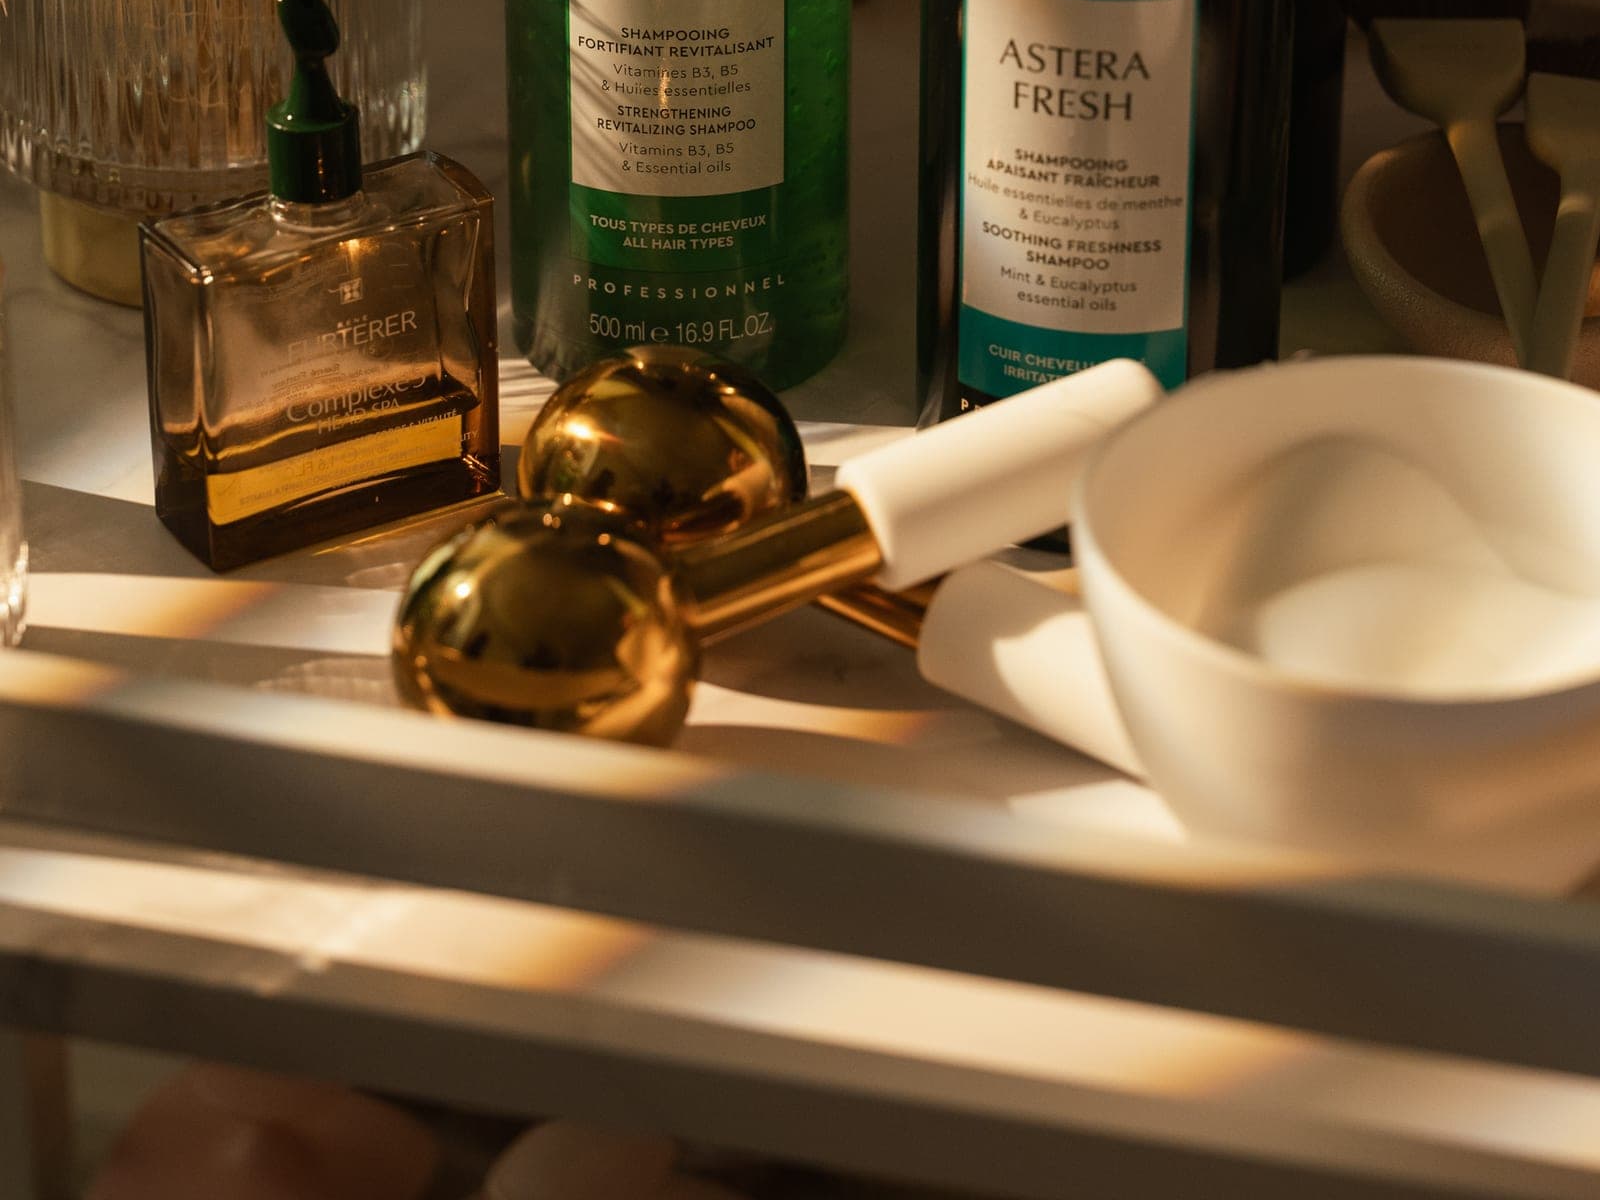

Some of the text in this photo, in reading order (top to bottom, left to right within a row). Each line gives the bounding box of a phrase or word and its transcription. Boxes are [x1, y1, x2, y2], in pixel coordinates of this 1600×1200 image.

[621, 27, 730, 42] SHAMPOOING
[578, 35, 775, 58] FORTIFIANT REVITALISANT
[999, 38, 1151, 81] ASTERA
[612, 63, 739, 81] Vitamines B3, B5
[601, 79, 611, 92] &
[664, 81, 751, 98] essentielles
[617, 105, 732, 120] STRENGTHENING
[1013, 81, 1134, 122] FRESH
[597, 118, 756, 136] REVITALIZING SHAMPOO
[619, 142, 735, 158] Vitamins B3, B5
[1014, 148, 1129, 173] SHAMPOOING
[621, 160, 732, 176] & Essential oils
[986, 158, 1059, 186] APAISANT
[1003, 186, 1092, 212] essentielles
[1096, 197, 1119, 211] de
[1122, 195, 1183, 212] menthe
[590, 214, 766, 235] TOUS TYPES DE CHEVEUX
[1018, 206, 1121, 232] & Eucalyptus
[623, 236, 734, 250] ALL HAIR TYPES
[982, 220, 1162, 254] SOOTHING FRESHNESS
[1026, 250, 1110, 272] SHAMPOO
[573, 273, 785, 300] PROFESSIONNEL
[1000, 266, 1137, 296] Mint & Eucalyptus
[1017, 289, 1117, 312] essential oils
[589, 313, 621, 339] 500
[625, 320, 645, 341] ml
[675, 321, 714, 344] 16.9
[988, 343, 1022, 363] CUIR
[1004, 364, 1062, 386] IRRITAT
[286, 377, 409, 424] Complexe
[317, 398, 401, 435] HEAD SPA
